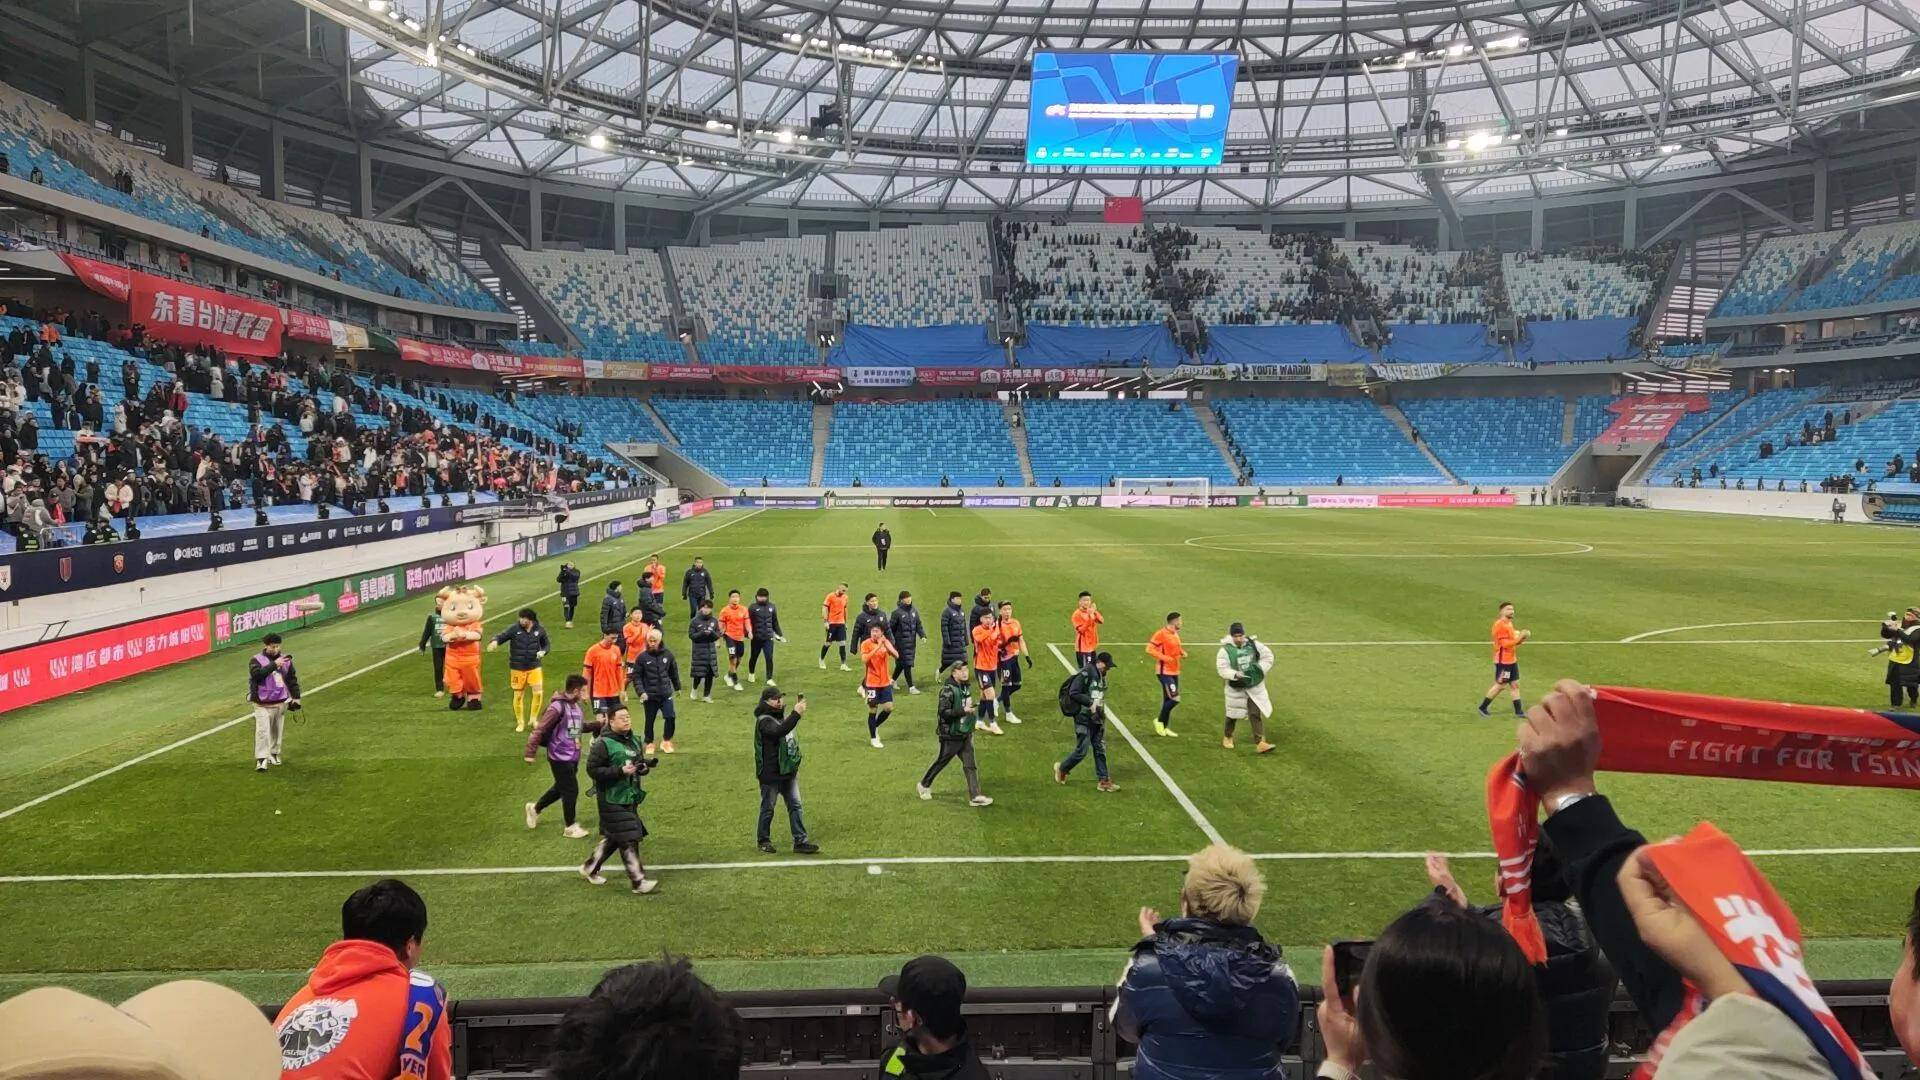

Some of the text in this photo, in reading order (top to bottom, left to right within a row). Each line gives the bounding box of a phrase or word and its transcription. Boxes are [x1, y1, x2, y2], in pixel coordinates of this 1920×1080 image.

[1630, 413, 1672, 423] 12
[360, 573, 395, 603] 青岛啤酒
[423, 564, 444, 586] moto
[71, 643, 124, 673] 湾区都市
[1668, 740, 1920, 778] FIGHT FOR TSIN
[405, 1001, 433, 1053] 2
